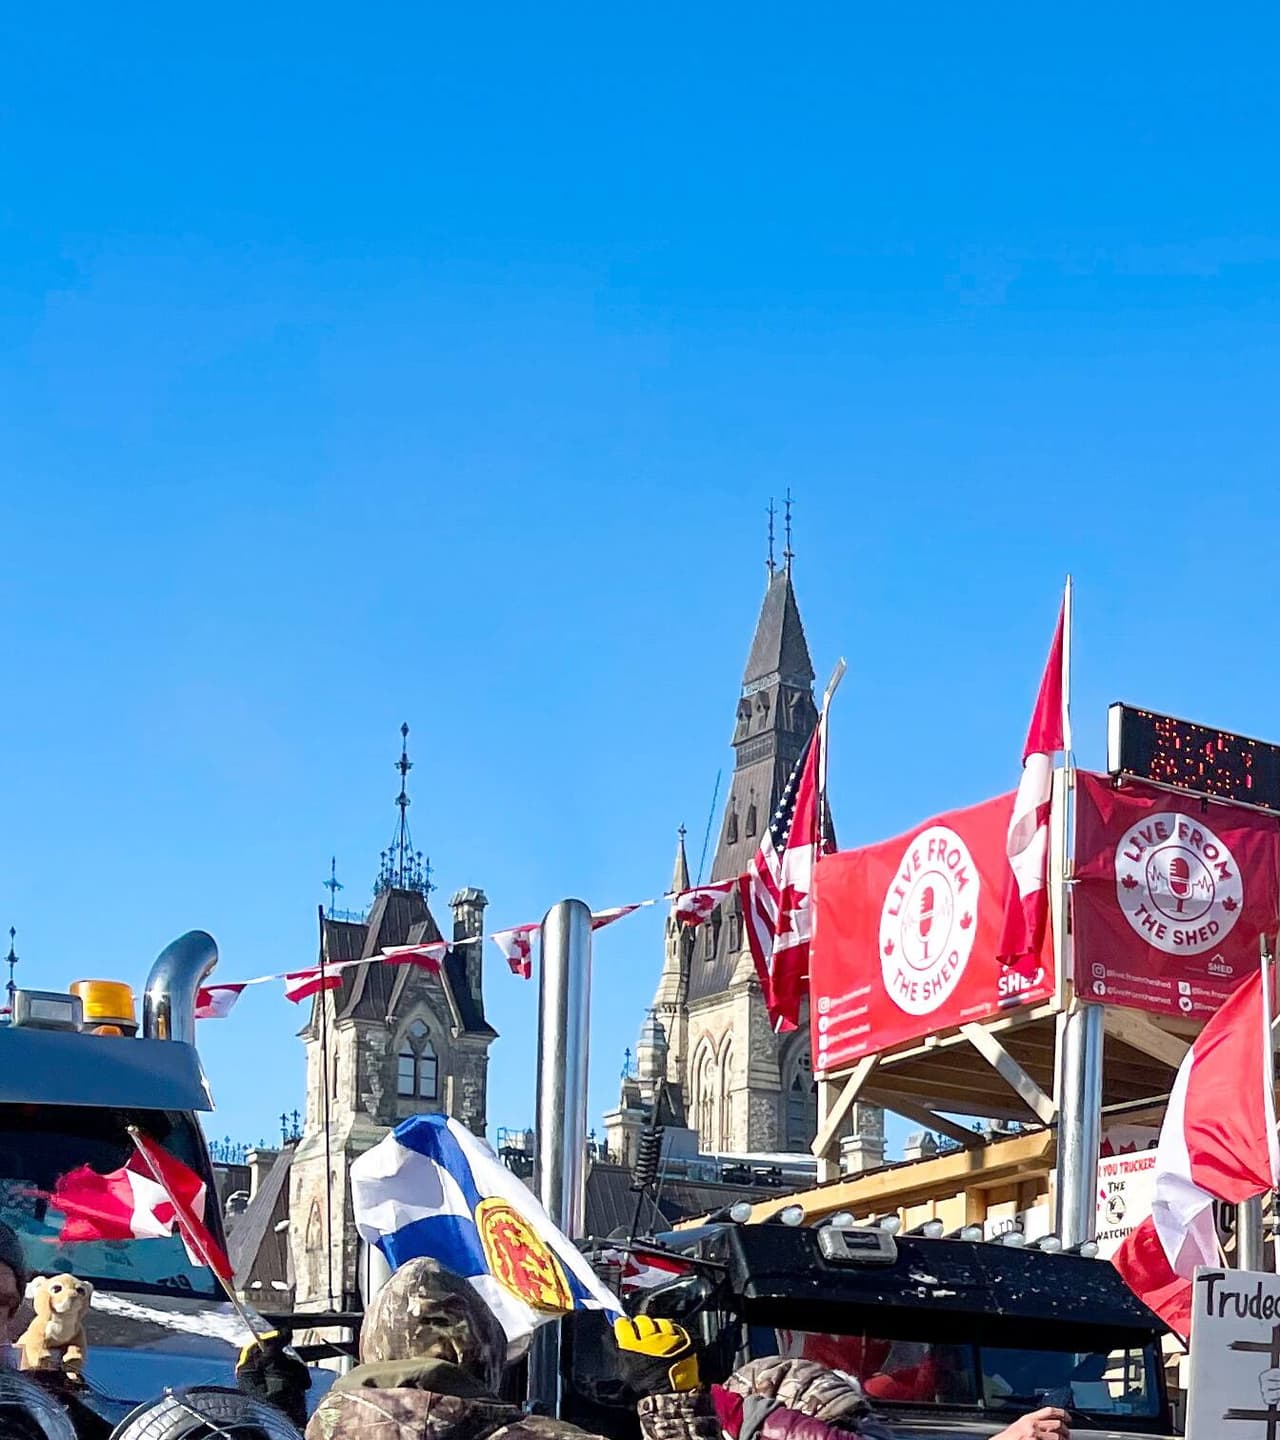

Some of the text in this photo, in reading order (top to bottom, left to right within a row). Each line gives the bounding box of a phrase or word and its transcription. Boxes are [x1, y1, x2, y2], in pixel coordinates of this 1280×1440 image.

[1123, 821, 1233, 882] LIVE FROM
[888, 838, 970, 917] LIVE FROM
[1134, 903, 1220, 946] THE SHED
[892, 967, 918, 1002] THE
[923, 950, 959, 1000] SHED
[1207, 962, 1234, 974] SHED
[1107, 1181, 1126, 1193] THE
